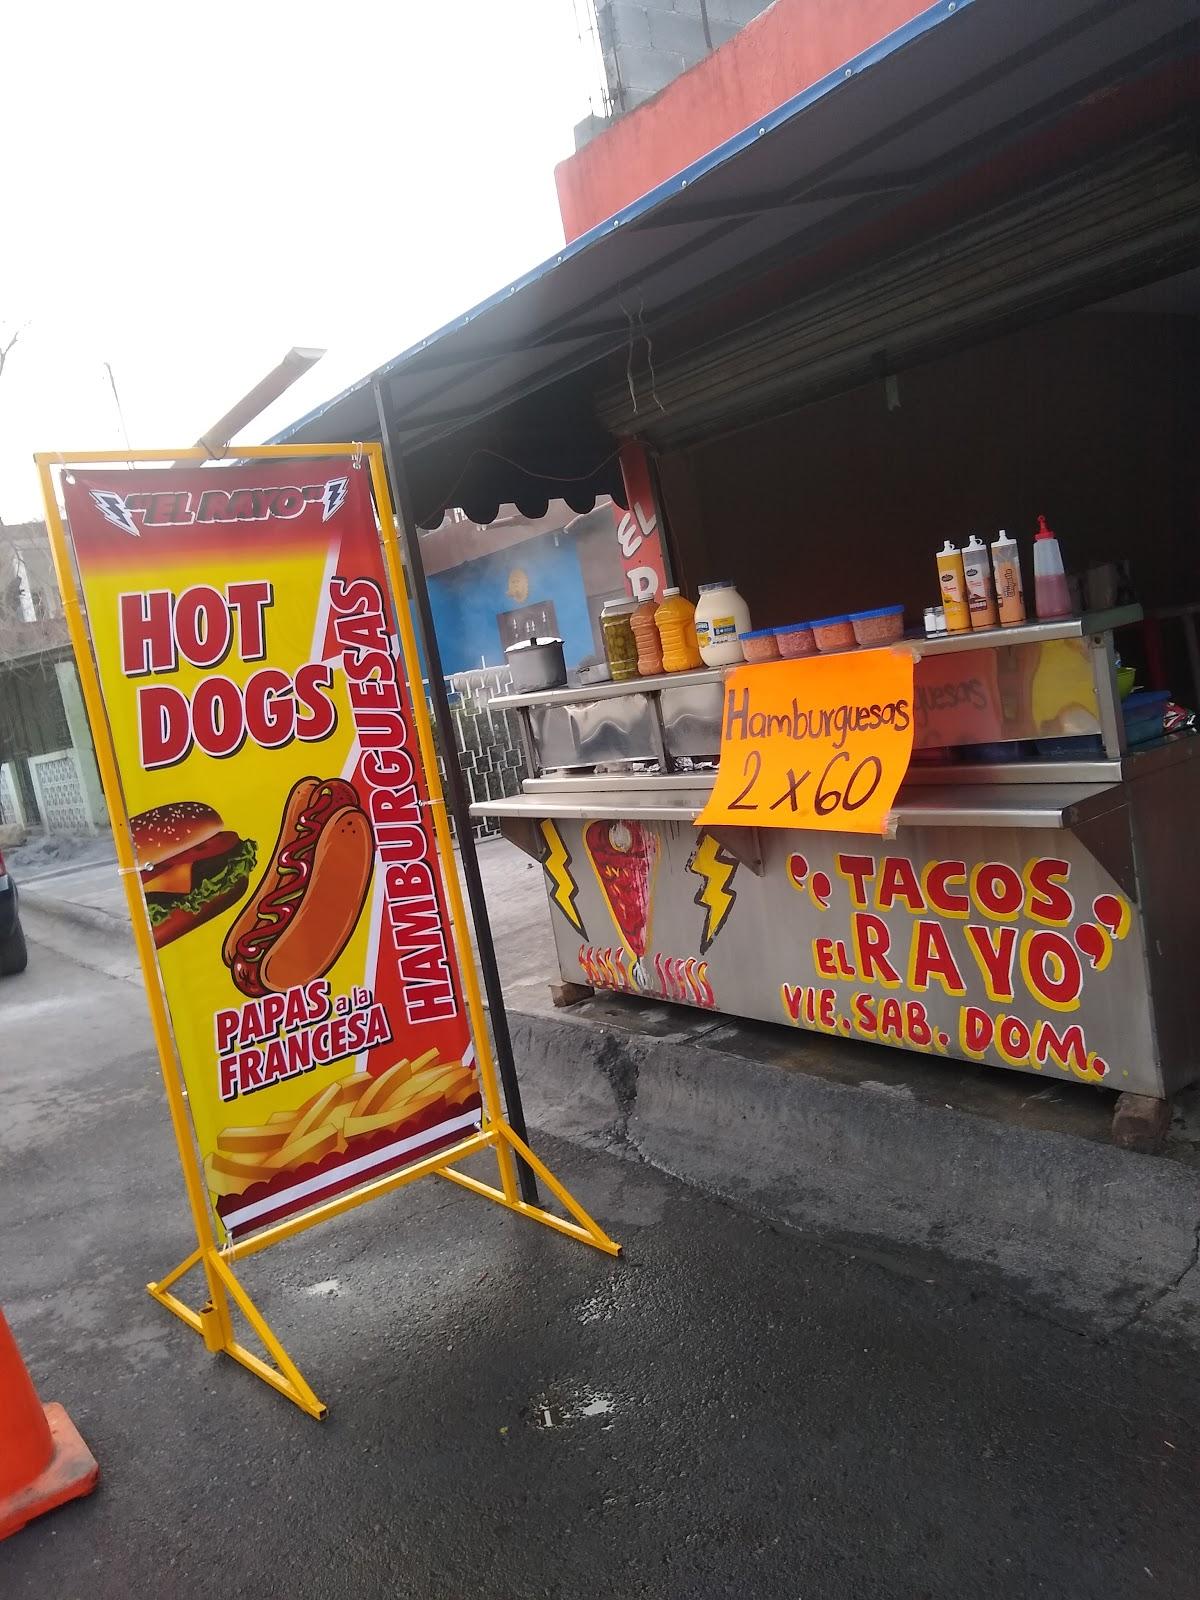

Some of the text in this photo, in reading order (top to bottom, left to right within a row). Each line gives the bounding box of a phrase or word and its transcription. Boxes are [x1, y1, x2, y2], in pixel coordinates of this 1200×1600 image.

[617, 502, 657, 558] EL
[118, 580, 274, 678] HOT
[136, 663, 337, 770] DOGS
[725, 687, 910, 749] Hamburguesas
[328, 576, 457, 1025] HAMBURGUESAS
[727, 750, 762, 810] 2
[814, 751, 883, 816] 60
[812, 937, 855, 979] EL
[214, 978, 373, 1054] PAPAS a la
[217, 1003, 393, 1103] FRANCESA
[959, 1004, 1109, 1082] DOM.
